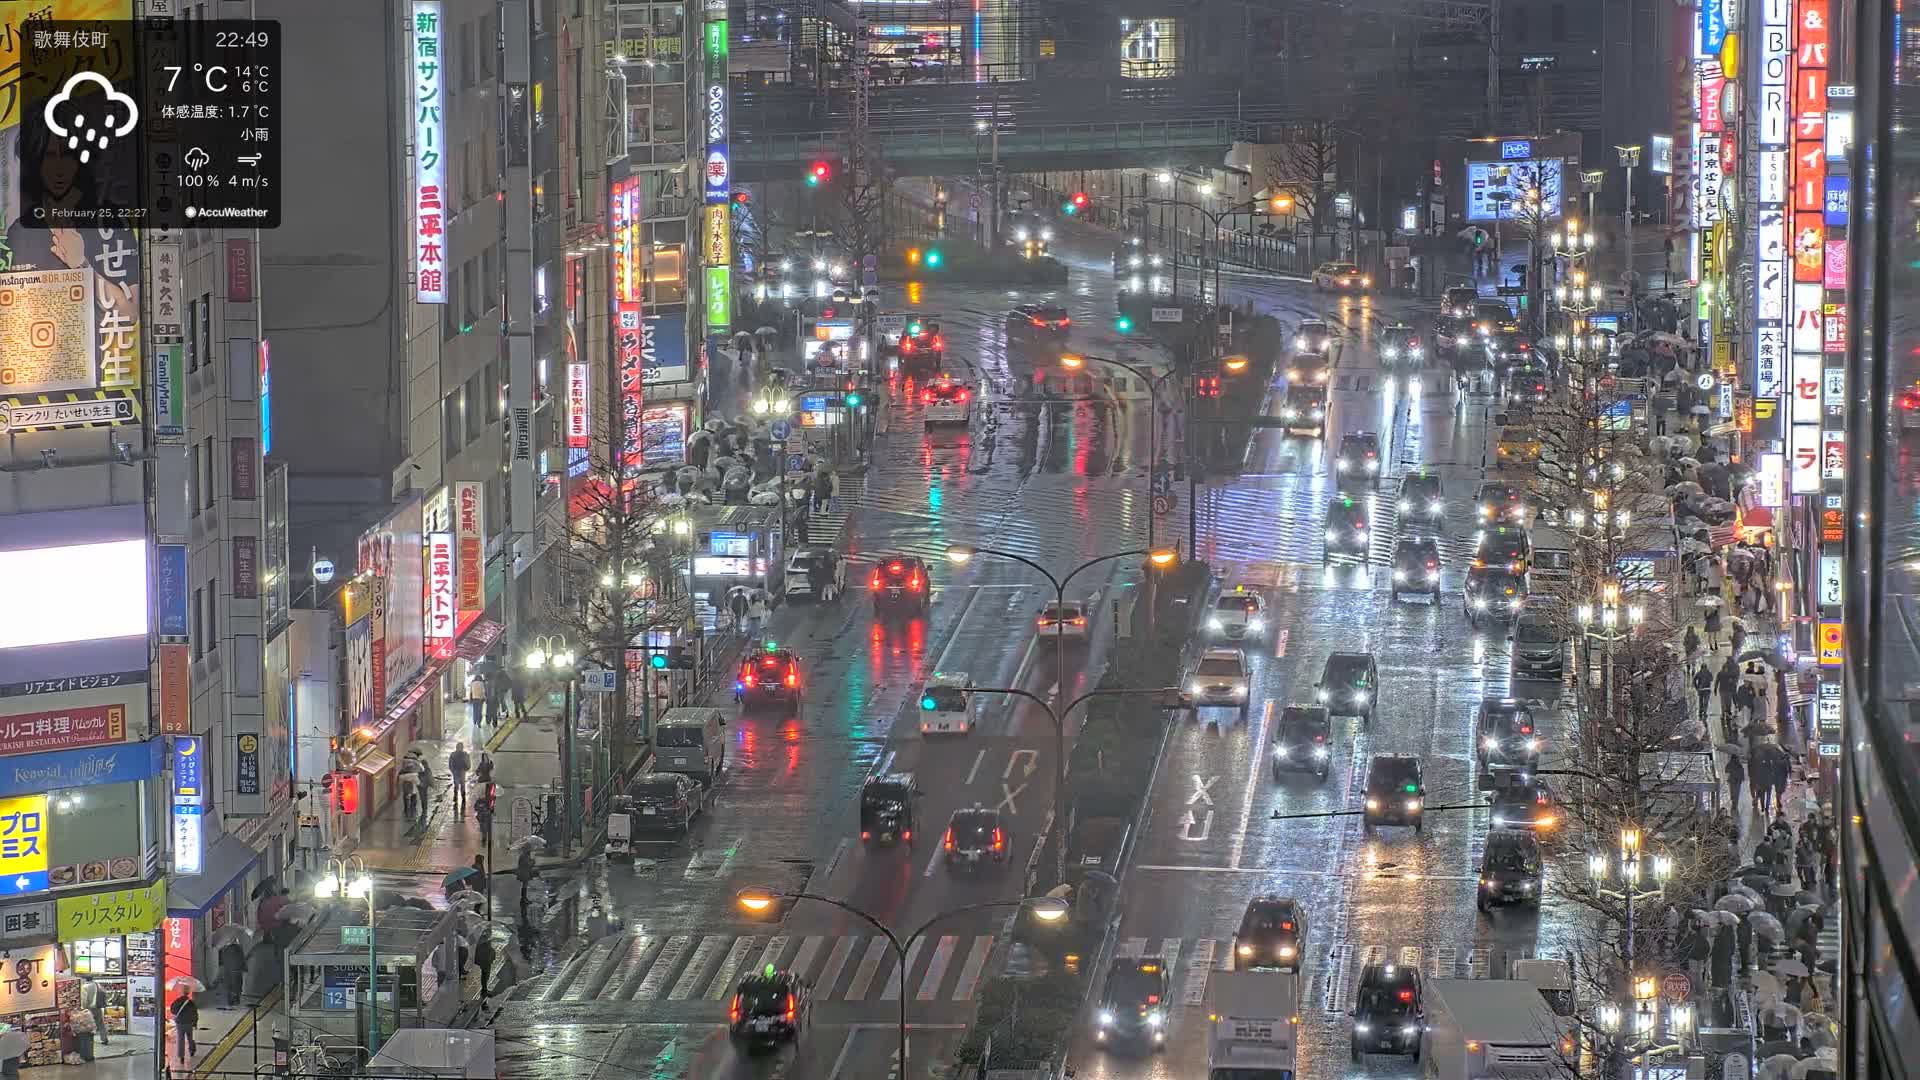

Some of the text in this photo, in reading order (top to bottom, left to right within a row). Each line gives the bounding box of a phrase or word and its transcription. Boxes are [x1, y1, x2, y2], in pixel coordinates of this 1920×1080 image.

[1708, 0, 1720, 46] ントラル
[1706, 88, 1719, 120] アコム
[417, 12, 442, 292] 新宿サンパーク 三平本館
[0, 274, 41, 289] nstagram
[159, 325, 176, 335] 3F
[1761, 331, 1774, 382] 大衆酒場
[158, 354, 170, 416] FamilyMart
[1796, 309, 1821, 469] パセラ
[15, 407, 112, 422] テンクリ たいせい先生
[1829, 406, 1843, 415] 5F
[461, 487, 473, 532] GAME
[1828, 498, 1840, 507] 3F
[714, 542, 726, 553] 10
[433, 543, 450, 630] 三平ストア
[26, 736, 69, 748] RESTAURANT
[180, 756, 188, 787] クリニック
[188, 756, 196, 782] いびきの
[181, 805, 195, 814] 2F
[1, 812, 41, 835] プロ
[1, 839, 41, 858] ミス
[5, 911, 41, 933] 囲碁
[71, 904, 143, 928] クリスタル
[327, 991, 344, 1005] 12
